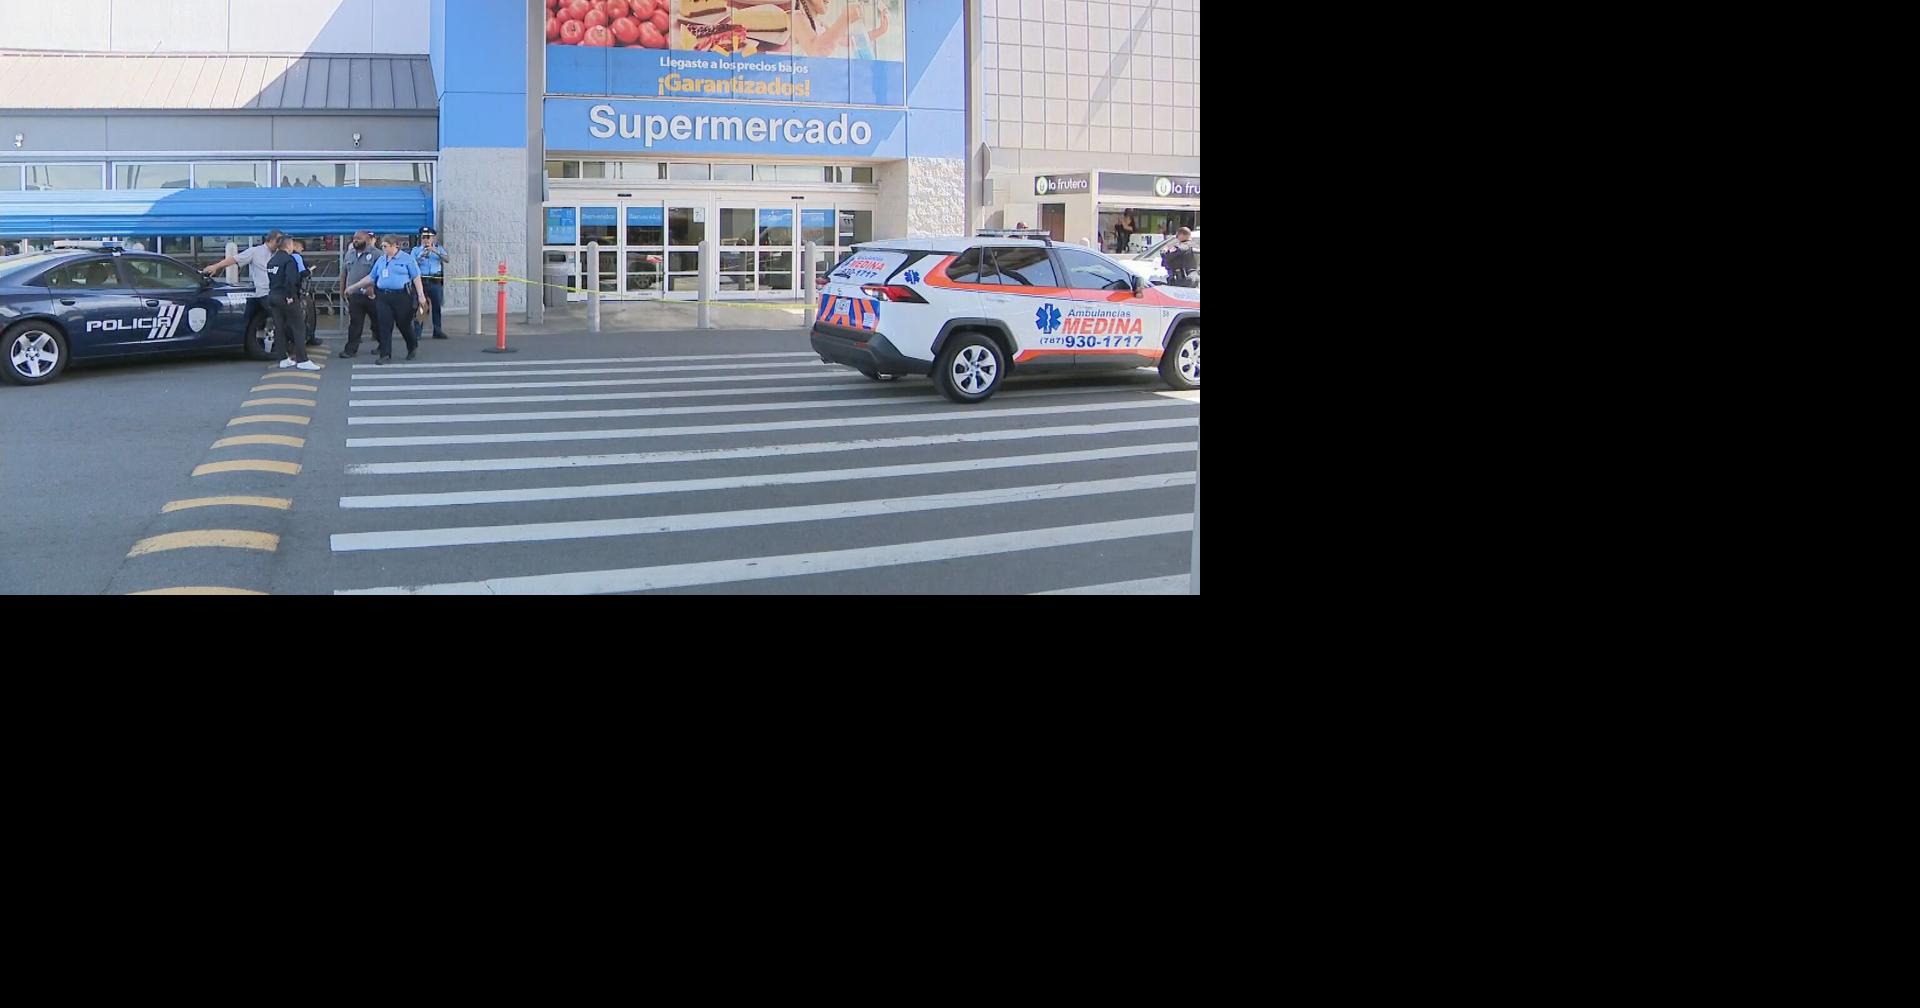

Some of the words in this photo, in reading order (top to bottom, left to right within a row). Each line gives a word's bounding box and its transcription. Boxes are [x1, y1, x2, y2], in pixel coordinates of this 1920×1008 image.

[660, 56, 709, 70] Llegaste
[710, 61, 717, 69] a
[719, 59, 737, 70] los
[737, 60, 776, 72] precios
[778, 62, 808, 75] bajos
[658, 72, 810, 97] ¡Garantizados!
[589, 104, 872, 147] Supermercado
[1048, 179, 1056, 190] la
[1057, 177, 1088, 189] frutera
[1171, 181, 1182, 194] la
[1068, 309, 1131, 318] Ambulancias
[86, 316, 171, 332] POLICIA
[1061, 318, 1142, 335] MEDINA
